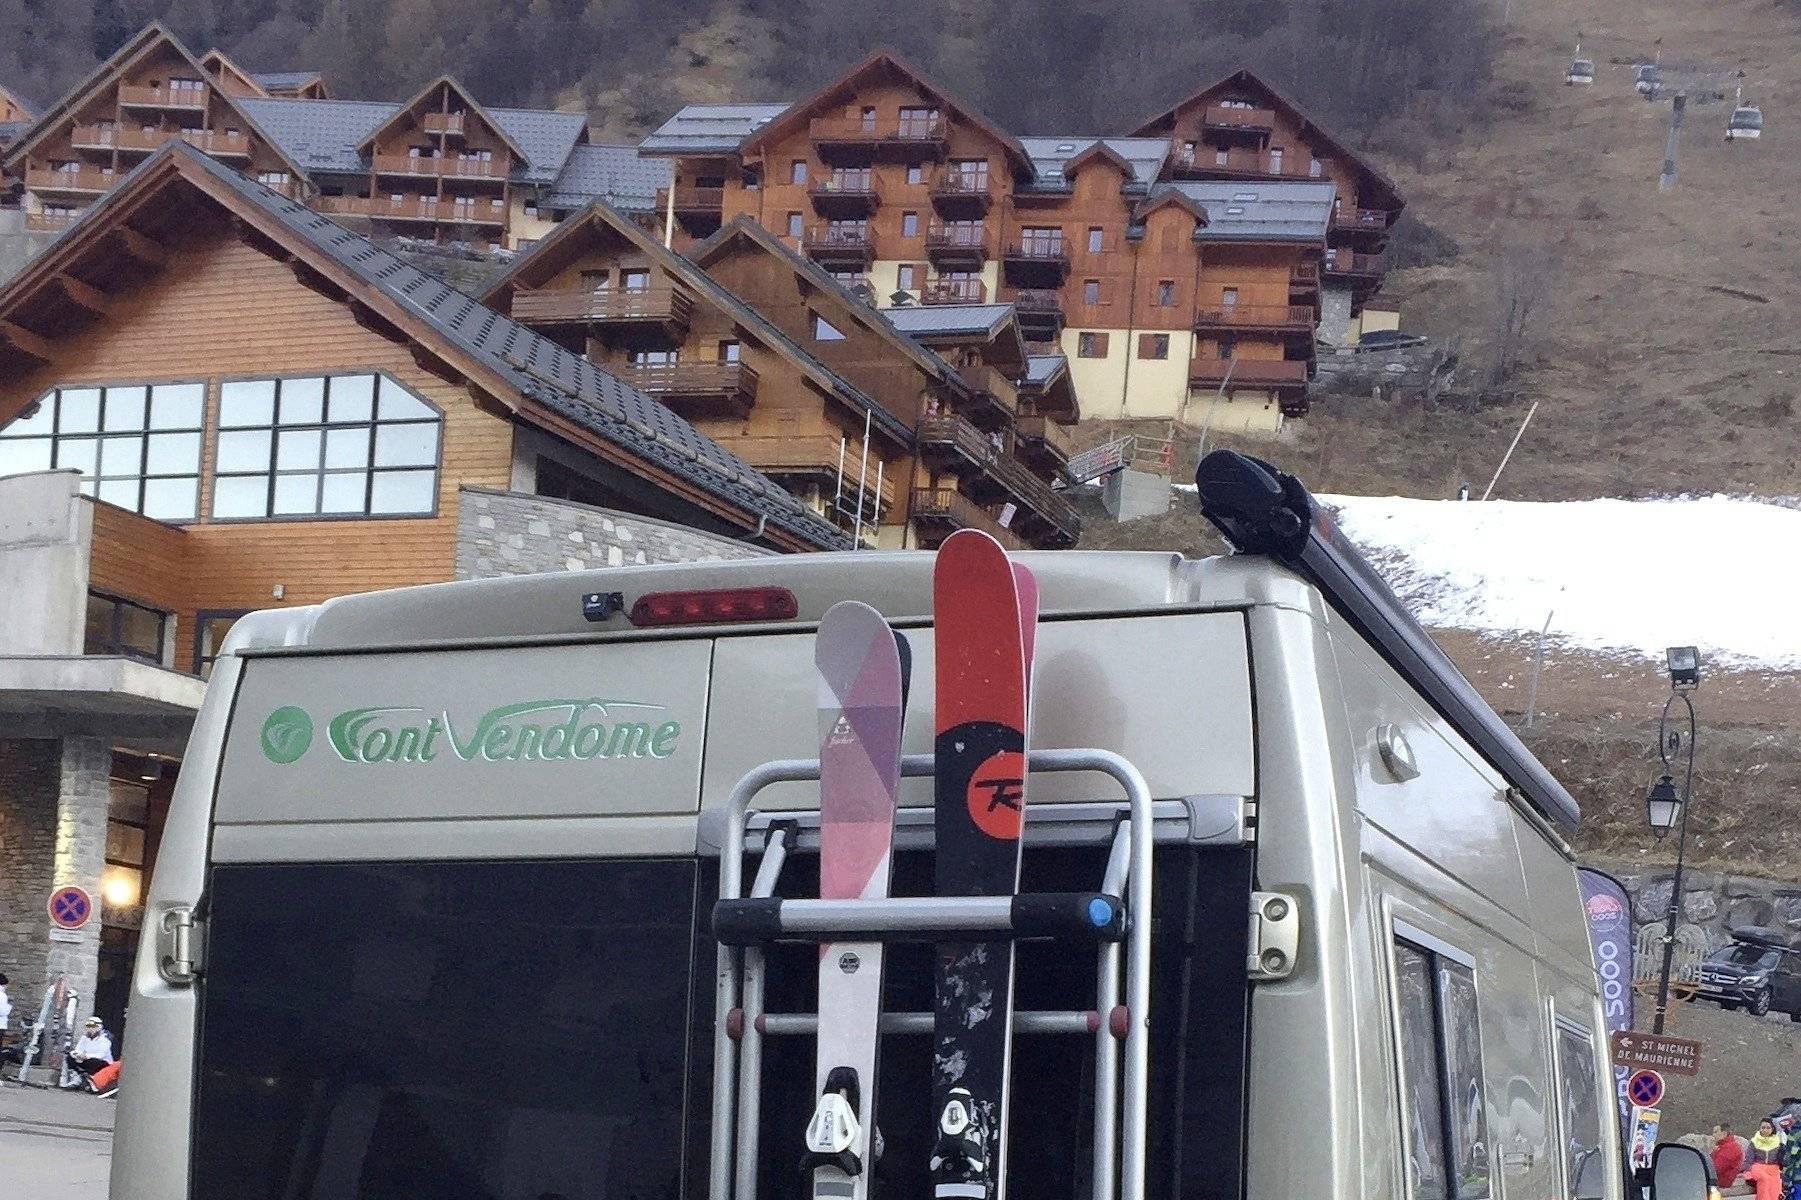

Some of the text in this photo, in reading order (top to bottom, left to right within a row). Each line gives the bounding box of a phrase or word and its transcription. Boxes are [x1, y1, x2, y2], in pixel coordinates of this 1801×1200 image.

[1641, 1040, 1696, 1056] ST MICHEL
[1617, 1049, 1695, 1069] DE MAURIENNE
